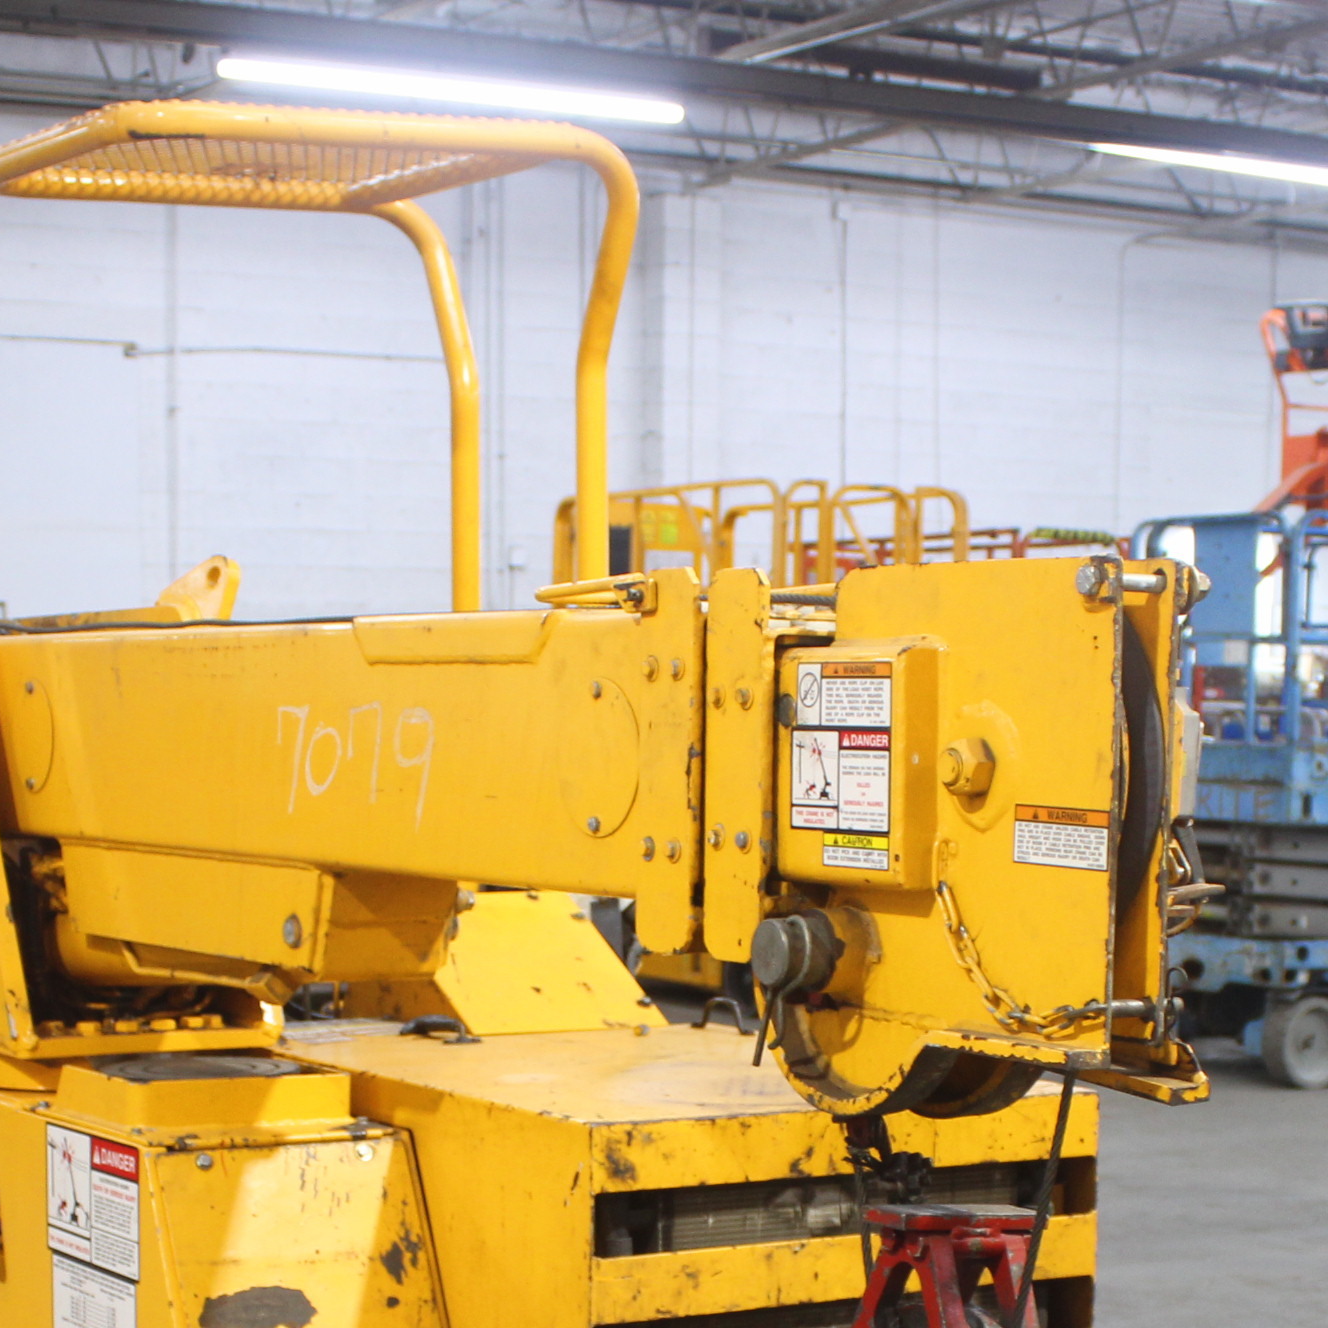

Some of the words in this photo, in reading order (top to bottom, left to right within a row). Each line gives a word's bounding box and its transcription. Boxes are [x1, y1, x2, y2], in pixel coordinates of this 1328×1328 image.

[843, 665, 876, 674] WARNING
[850, 734, 889, 746] DANGER
[278, 701, 434, 834] 7079
[1047, 810, 1088, 823] WARNING
[842, 836, 873, 847] CAUTION
[101, 1147, 136, 1173] DANGER
